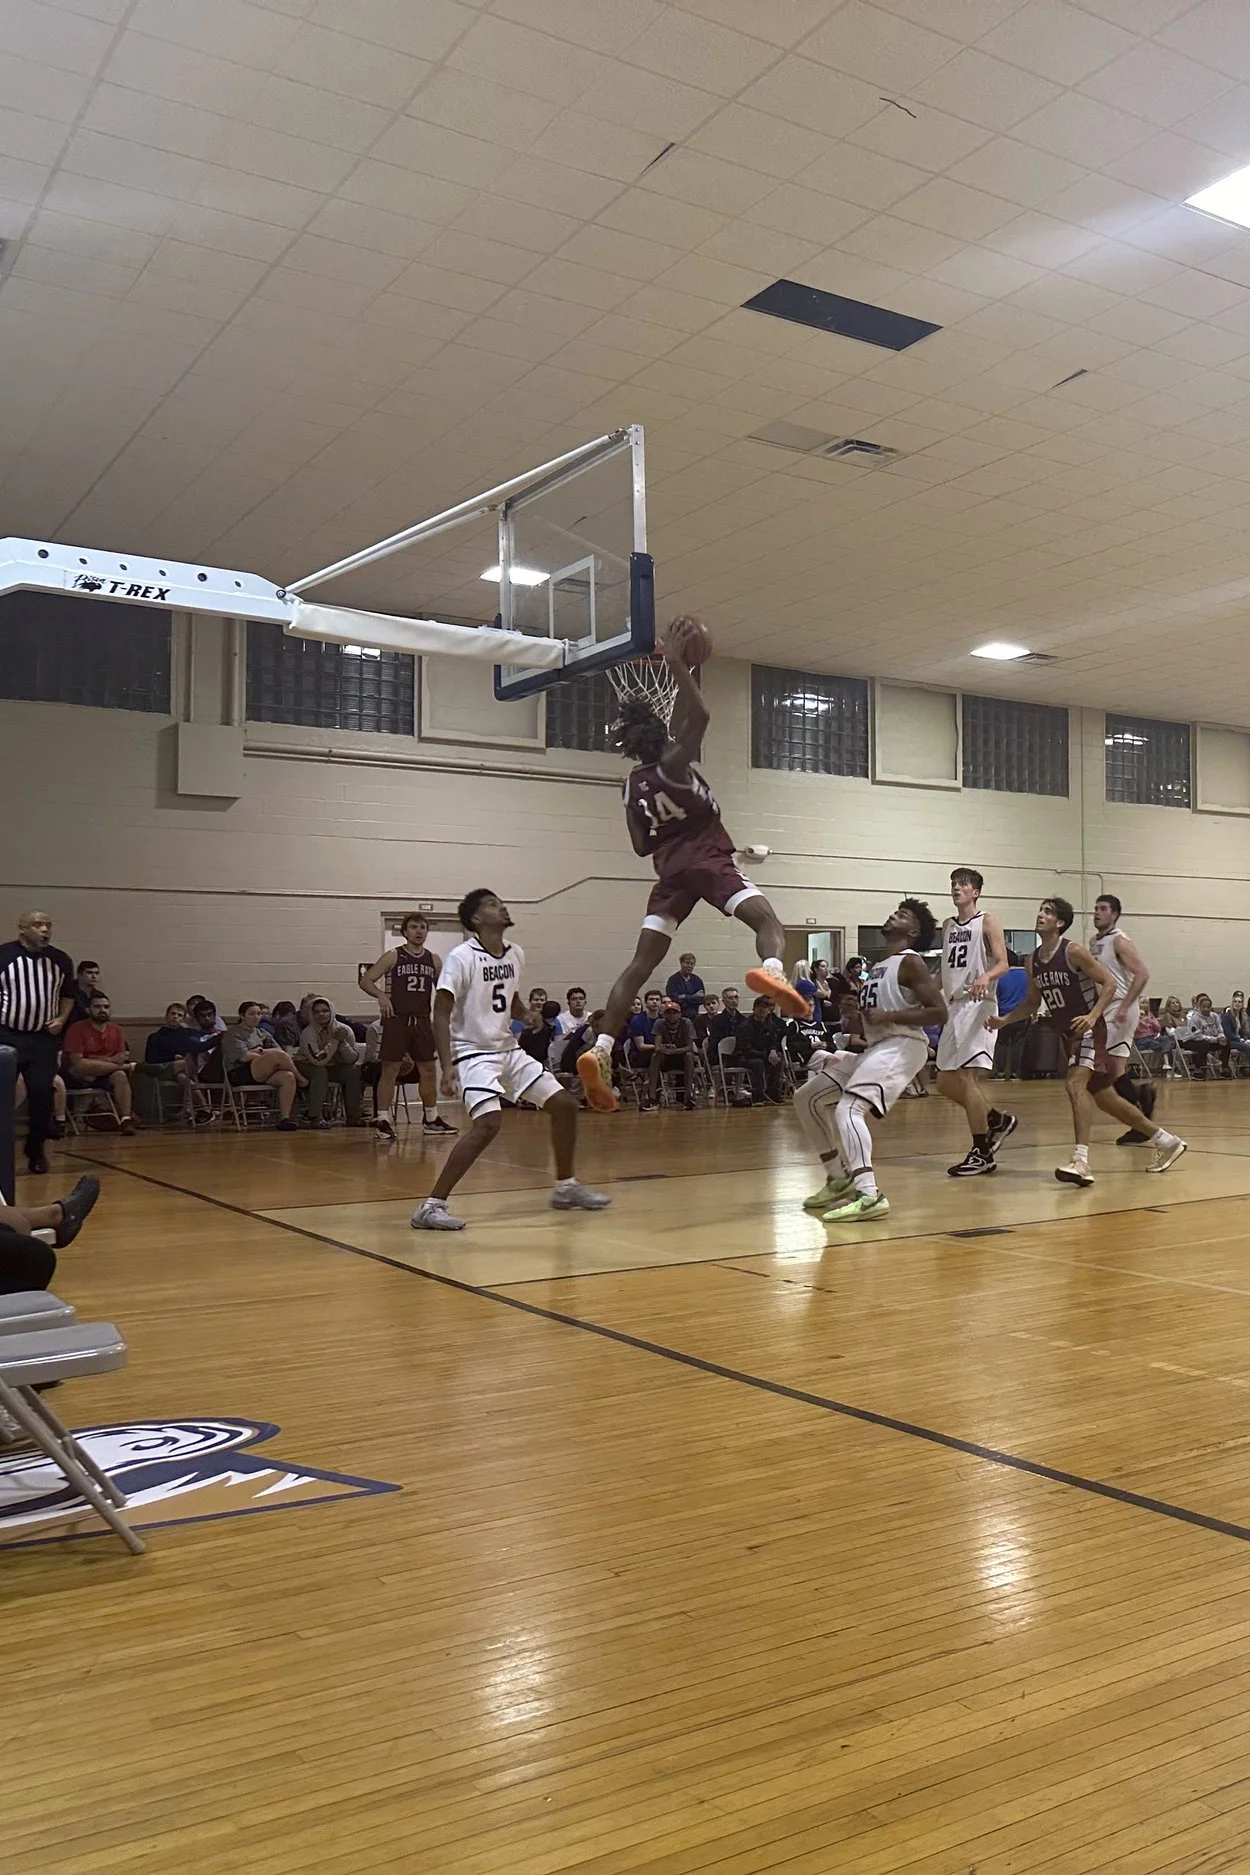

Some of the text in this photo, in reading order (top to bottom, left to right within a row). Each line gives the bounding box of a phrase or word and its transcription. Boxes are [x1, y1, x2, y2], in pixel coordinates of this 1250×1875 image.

[109, 581, 171, 600] T-REX
[948, 945, 968, 968] 42
[397, 963, 418, 977] EAGLE
[483, 963, 515, 982] BEACON
[1050, 971, 1070, 986] RAYS
[407, 975, 426, 992] 21
[492, 983, 507, 1013] 5
[1043, 988, 1066, 1010] 20
